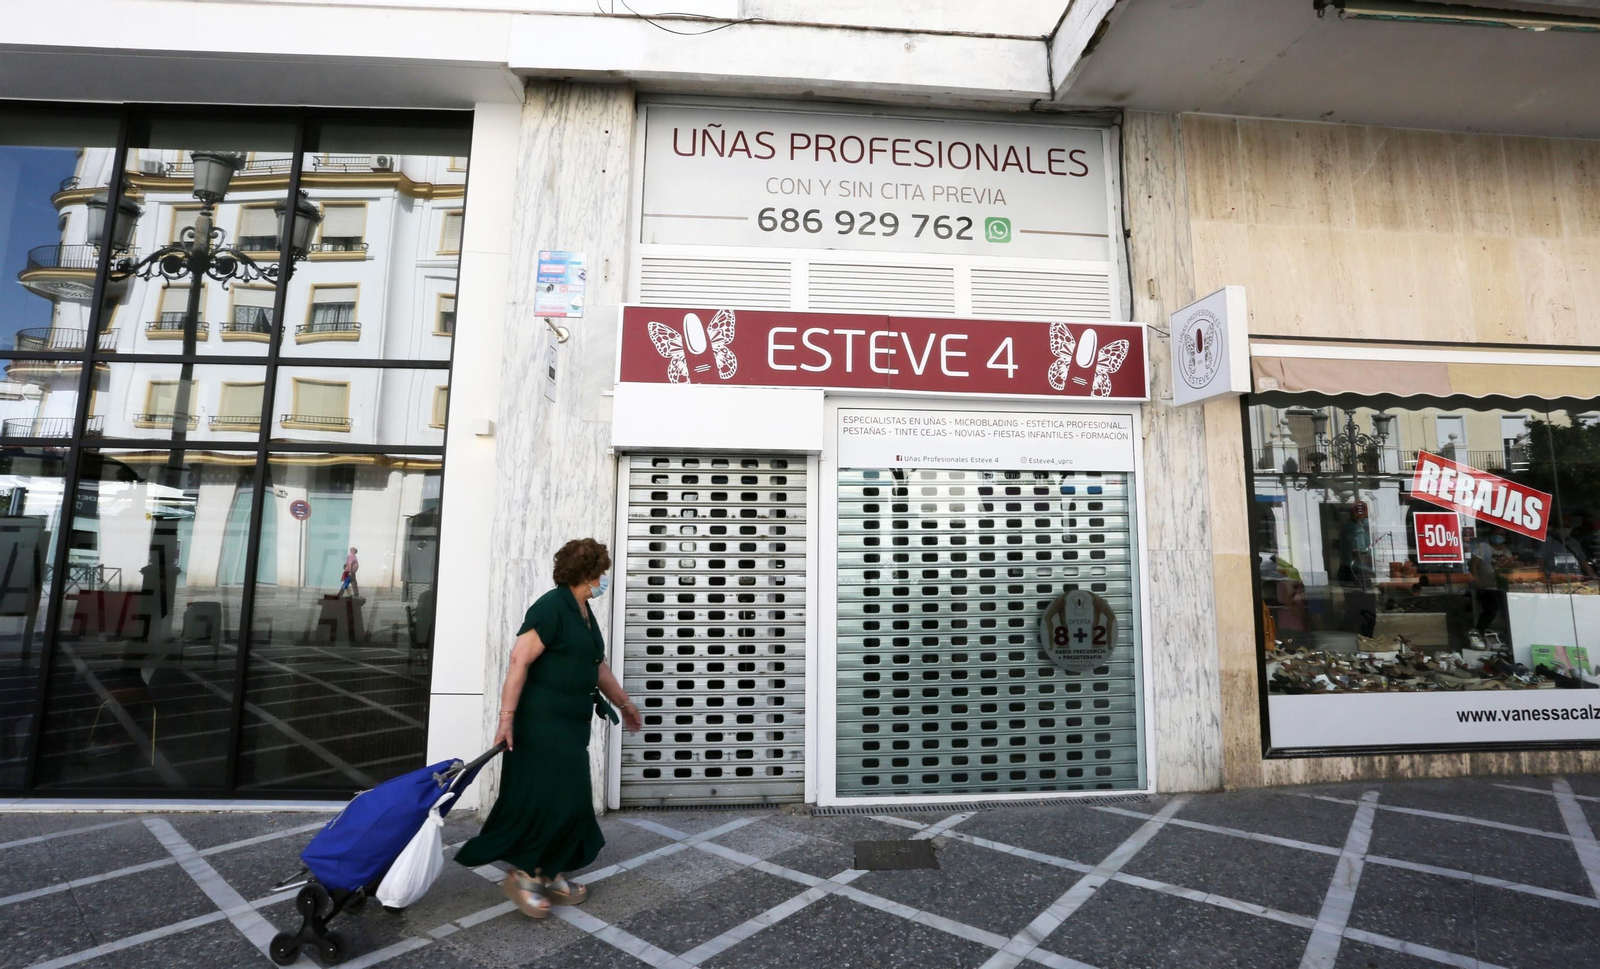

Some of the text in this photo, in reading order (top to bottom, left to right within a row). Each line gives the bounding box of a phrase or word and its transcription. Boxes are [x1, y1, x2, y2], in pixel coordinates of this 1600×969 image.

[673, 123, 1089, 177] UÑAS PROFESIONALES
[766, 177, 1006, 205] CON Y SIN CITA PREVIA
[757, 207, 973, 240] 686 929 762
[768, 327, 1019, 379] ESTEVE 4
[1188, 373, 1210, 385] ESTEVE
[843, 416, 907, 425] ESPECIALISTAS
[909, 417, 921, 425] EN
[923, 416, 947, 426] UÑAS
[954, 418, 1018, 427] MICROBLADING
[1026, 419, 1064, 428] ESTÉTICA
[843, 426, 886, 435] PESTAÑAS
[894, 428, 918, 436] TINTE
[920, 428, 947, 437] CEJAS
[954, 429, 986, 437] NOVIAS
[993, 430, 1025, 438] FIESTAS
[1027, 431, 1073, 439] INFANTILES
[1081, 431, 1129, 440] FORMACIÓN
[1418, 460, 1543, 531] REBAJAS
[1456, 704, 1600, 722] www.vanessacalz
